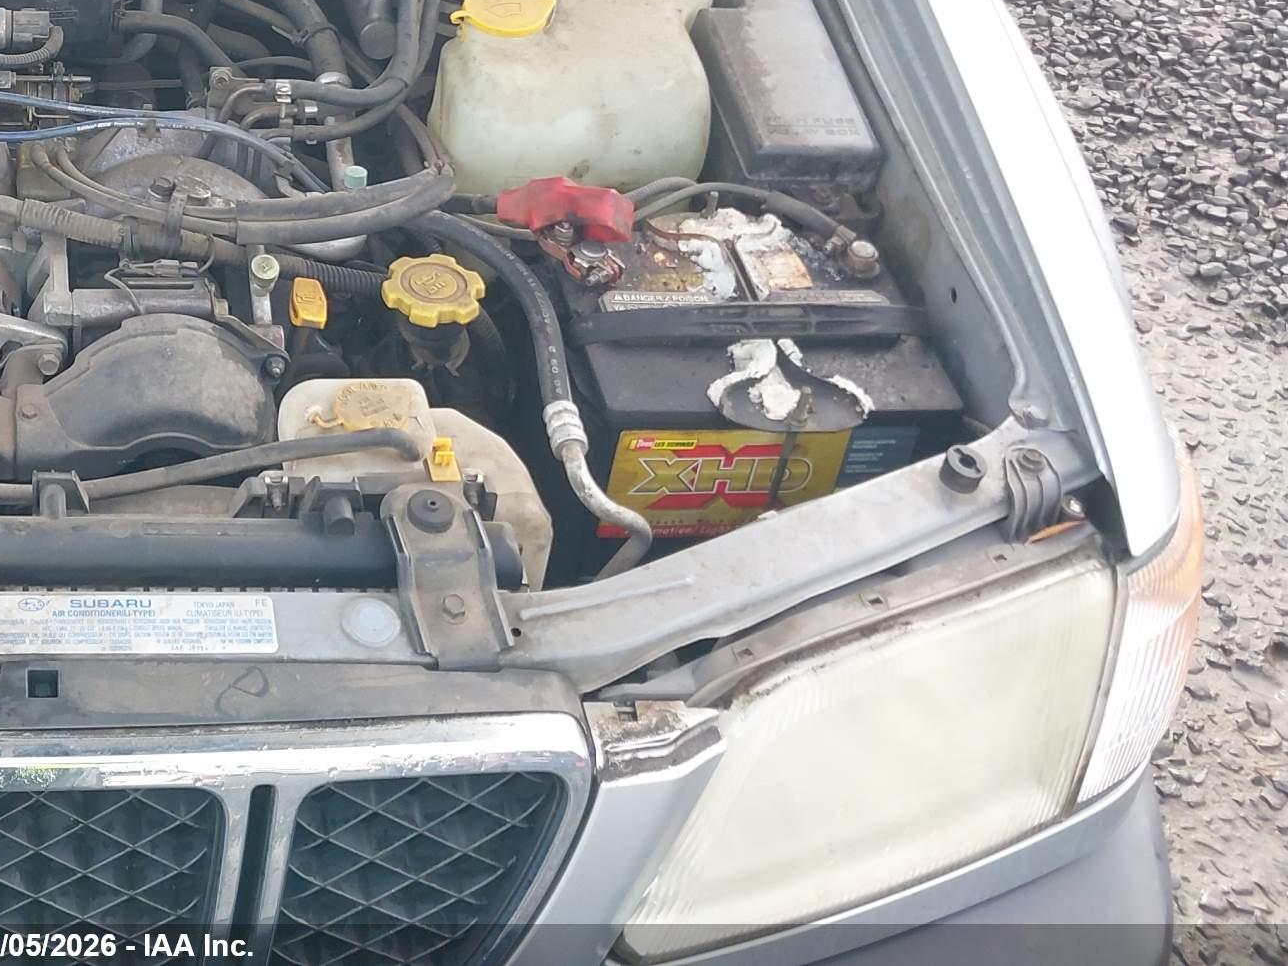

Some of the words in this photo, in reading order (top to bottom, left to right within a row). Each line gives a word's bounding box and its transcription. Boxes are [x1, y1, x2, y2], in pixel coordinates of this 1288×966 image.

[629, 456, 813, 495] XHD
[69, 598, 152, 609] SUBARU
[51, 609, 66, 618] AIR
